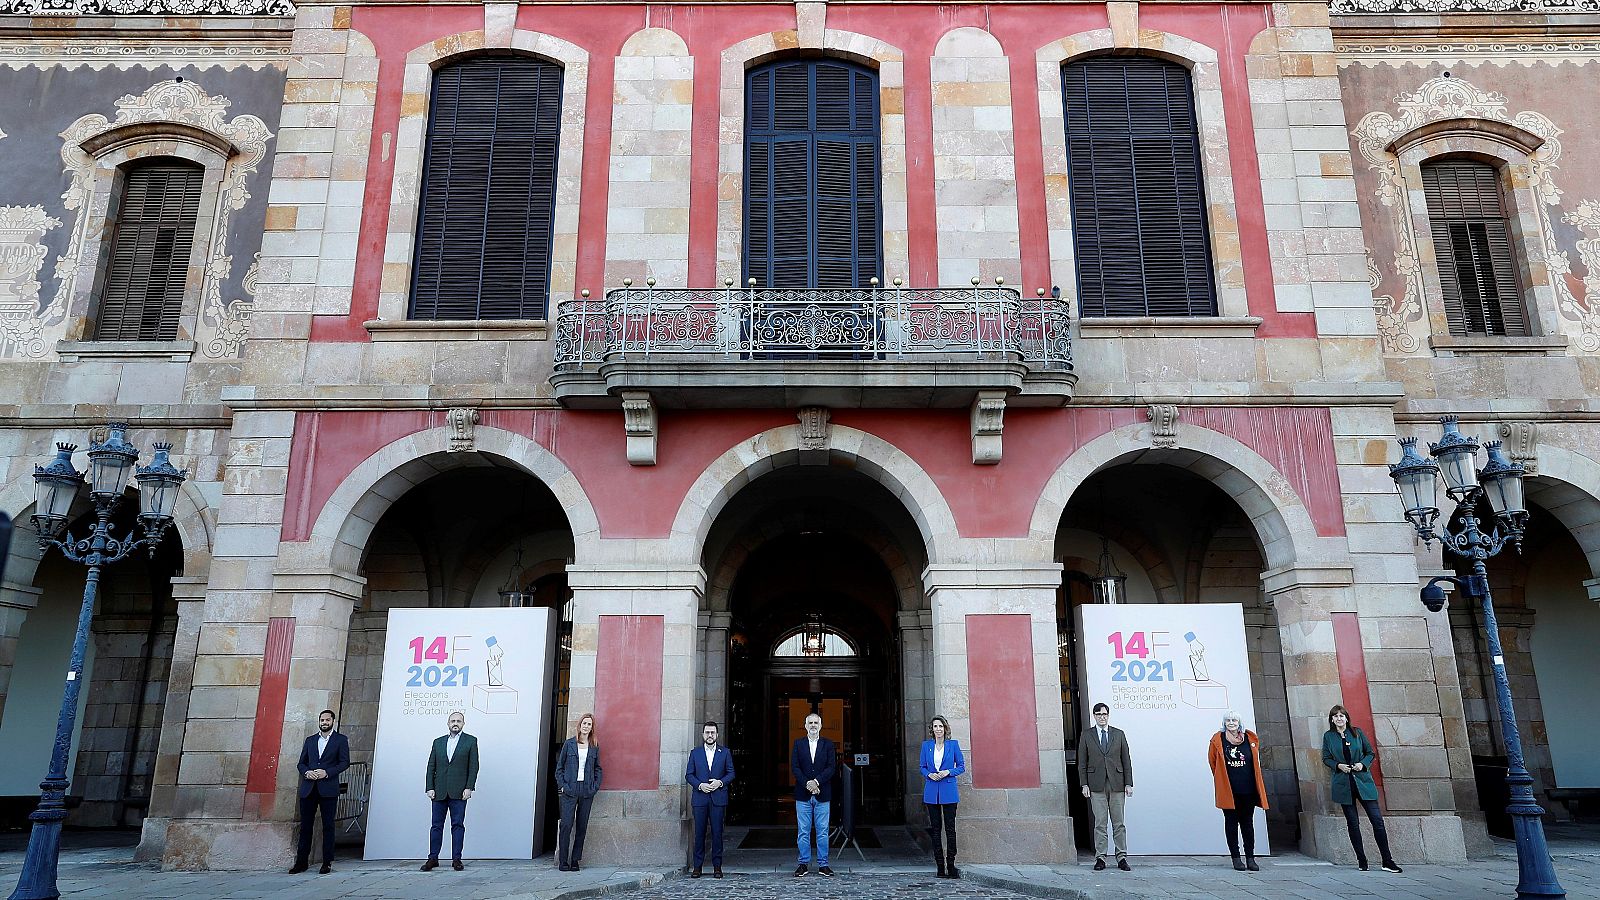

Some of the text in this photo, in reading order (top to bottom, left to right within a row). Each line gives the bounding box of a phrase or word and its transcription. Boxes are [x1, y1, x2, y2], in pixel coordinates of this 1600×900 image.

[409, 635, 473, 664] 14F
[1107, 631, 1170, 659] 14F
[1111, 660, 1174, 682] 2021
[406, 665, 470, 687] 2021
[1112, 685, 1157, 694] Eleccions
[404, 691, 449, 699] Eleccions
[1112, 693, 1172, 701] al Parlament
[403, 707, 415, 715] de
[1113, 702, 1177, 711] de Catalunya
